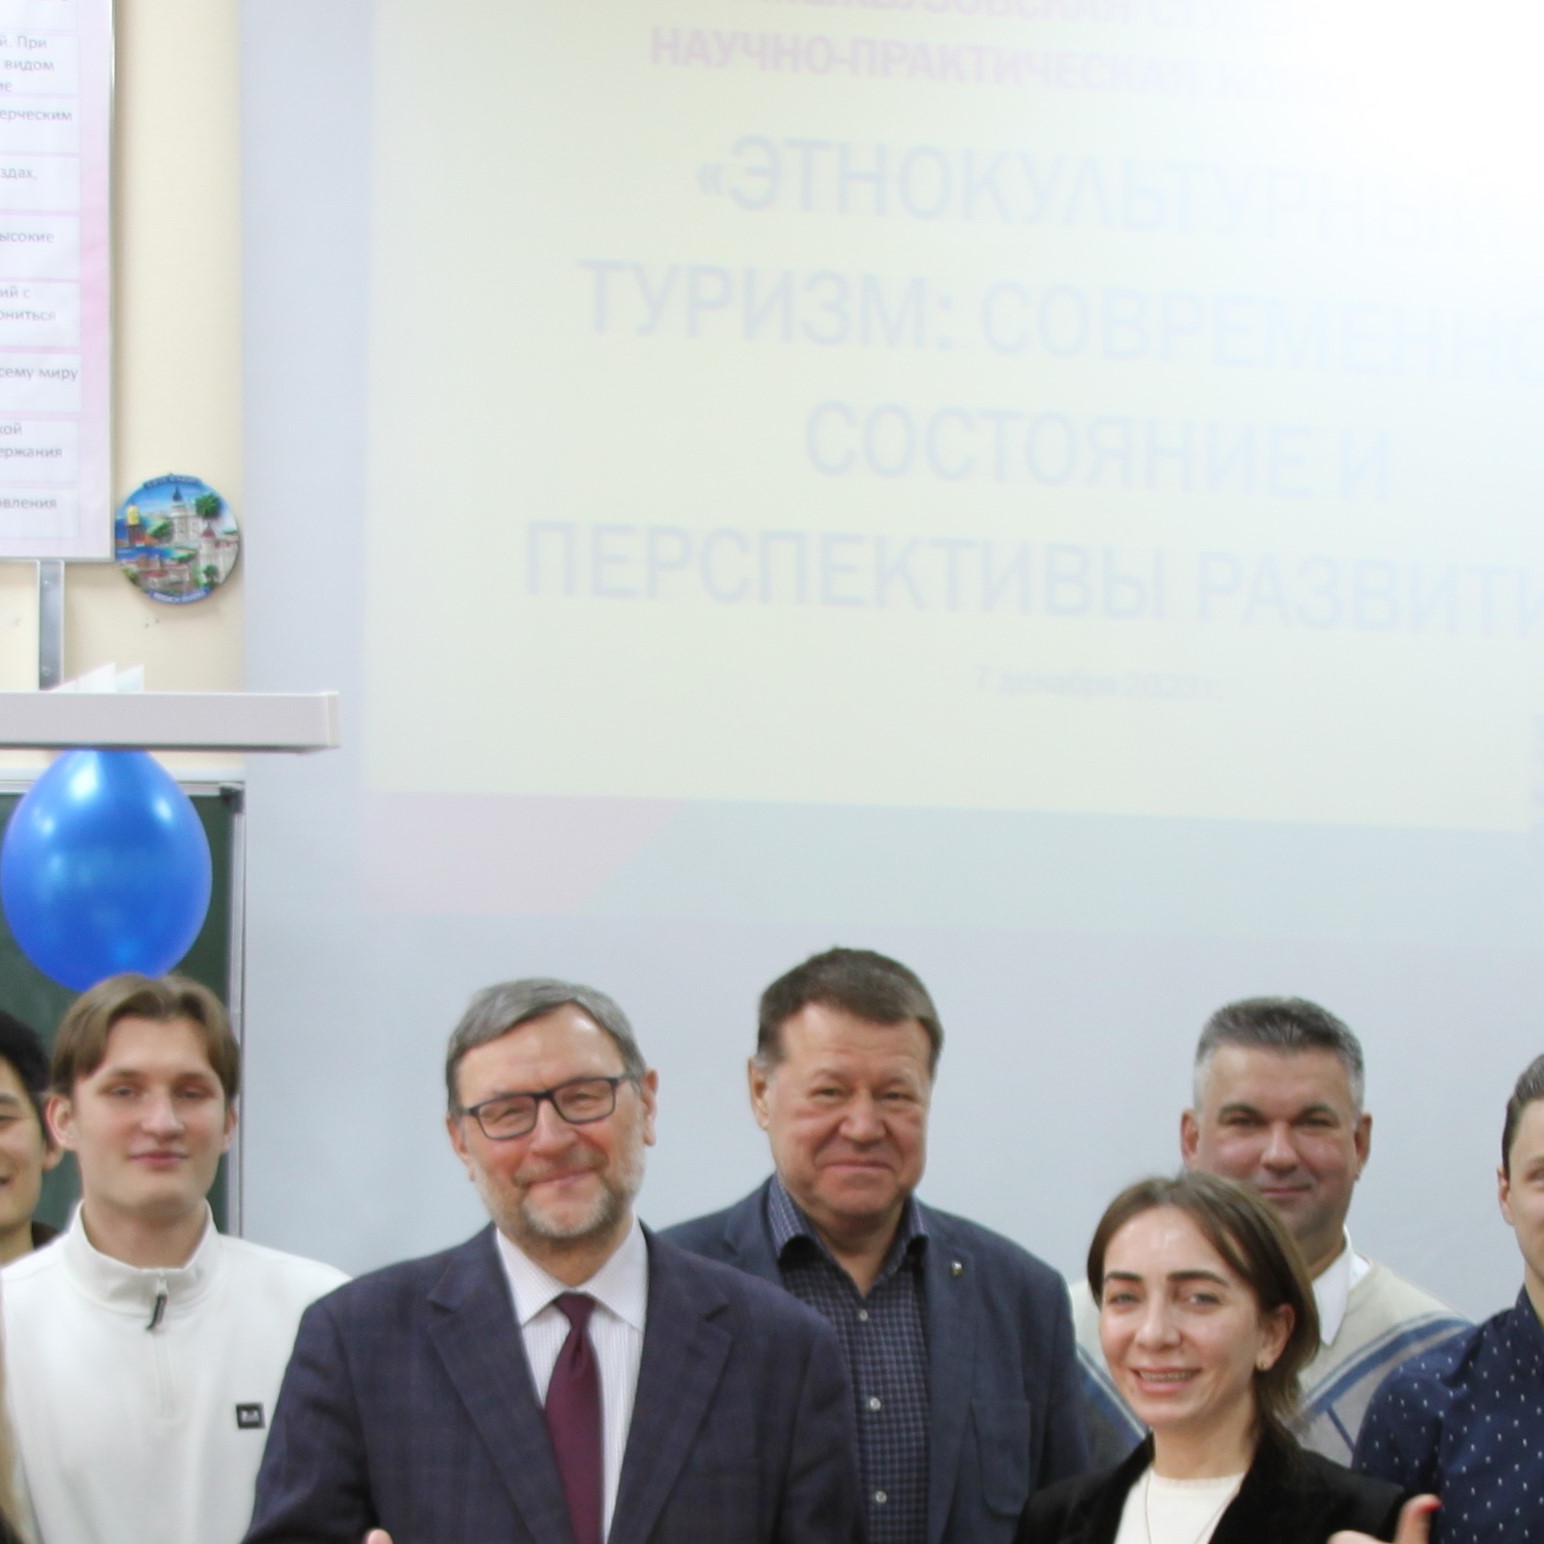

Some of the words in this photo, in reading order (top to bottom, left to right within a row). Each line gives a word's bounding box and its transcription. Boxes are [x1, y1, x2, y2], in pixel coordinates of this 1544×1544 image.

[576, 258, 959, 352] ТУРИЗМ:
[805, 400, 1313, 499] СОСТОЯНИЕ
[1338, 429, 1392, 502] И
[526, 519, 1167, 621] ПЕРСПЕКТИВЫ
